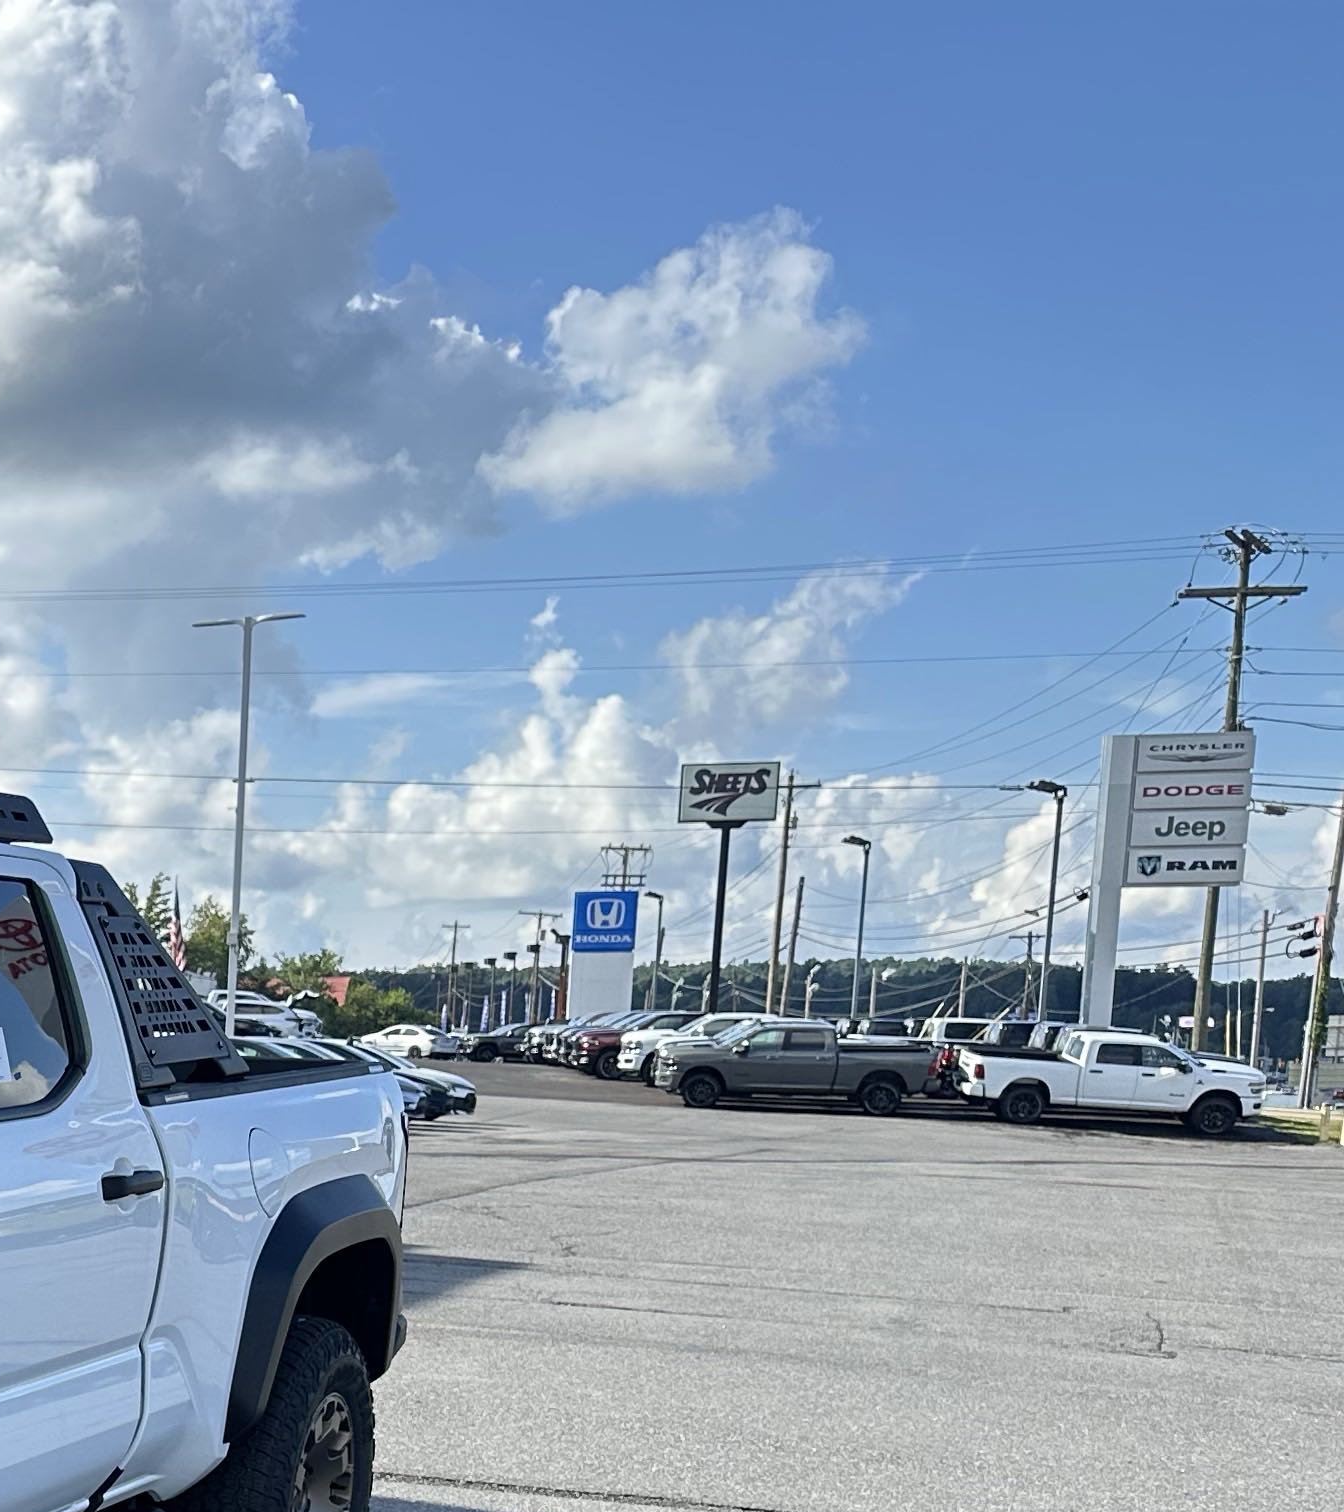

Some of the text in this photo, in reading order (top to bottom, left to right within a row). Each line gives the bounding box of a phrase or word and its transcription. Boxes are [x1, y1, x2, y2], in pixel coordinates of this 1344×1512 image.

[1149, 743, 1245, 752] CHRYSLER
[689, 768, 771, 796] SHEETS
[1142, 785, 1244, 798] DODGE
[1154, 816, 1225, 840] Jeep
[1166, 860, 1237, 871] RAM
[574, 934, 632, 943] HONDA
